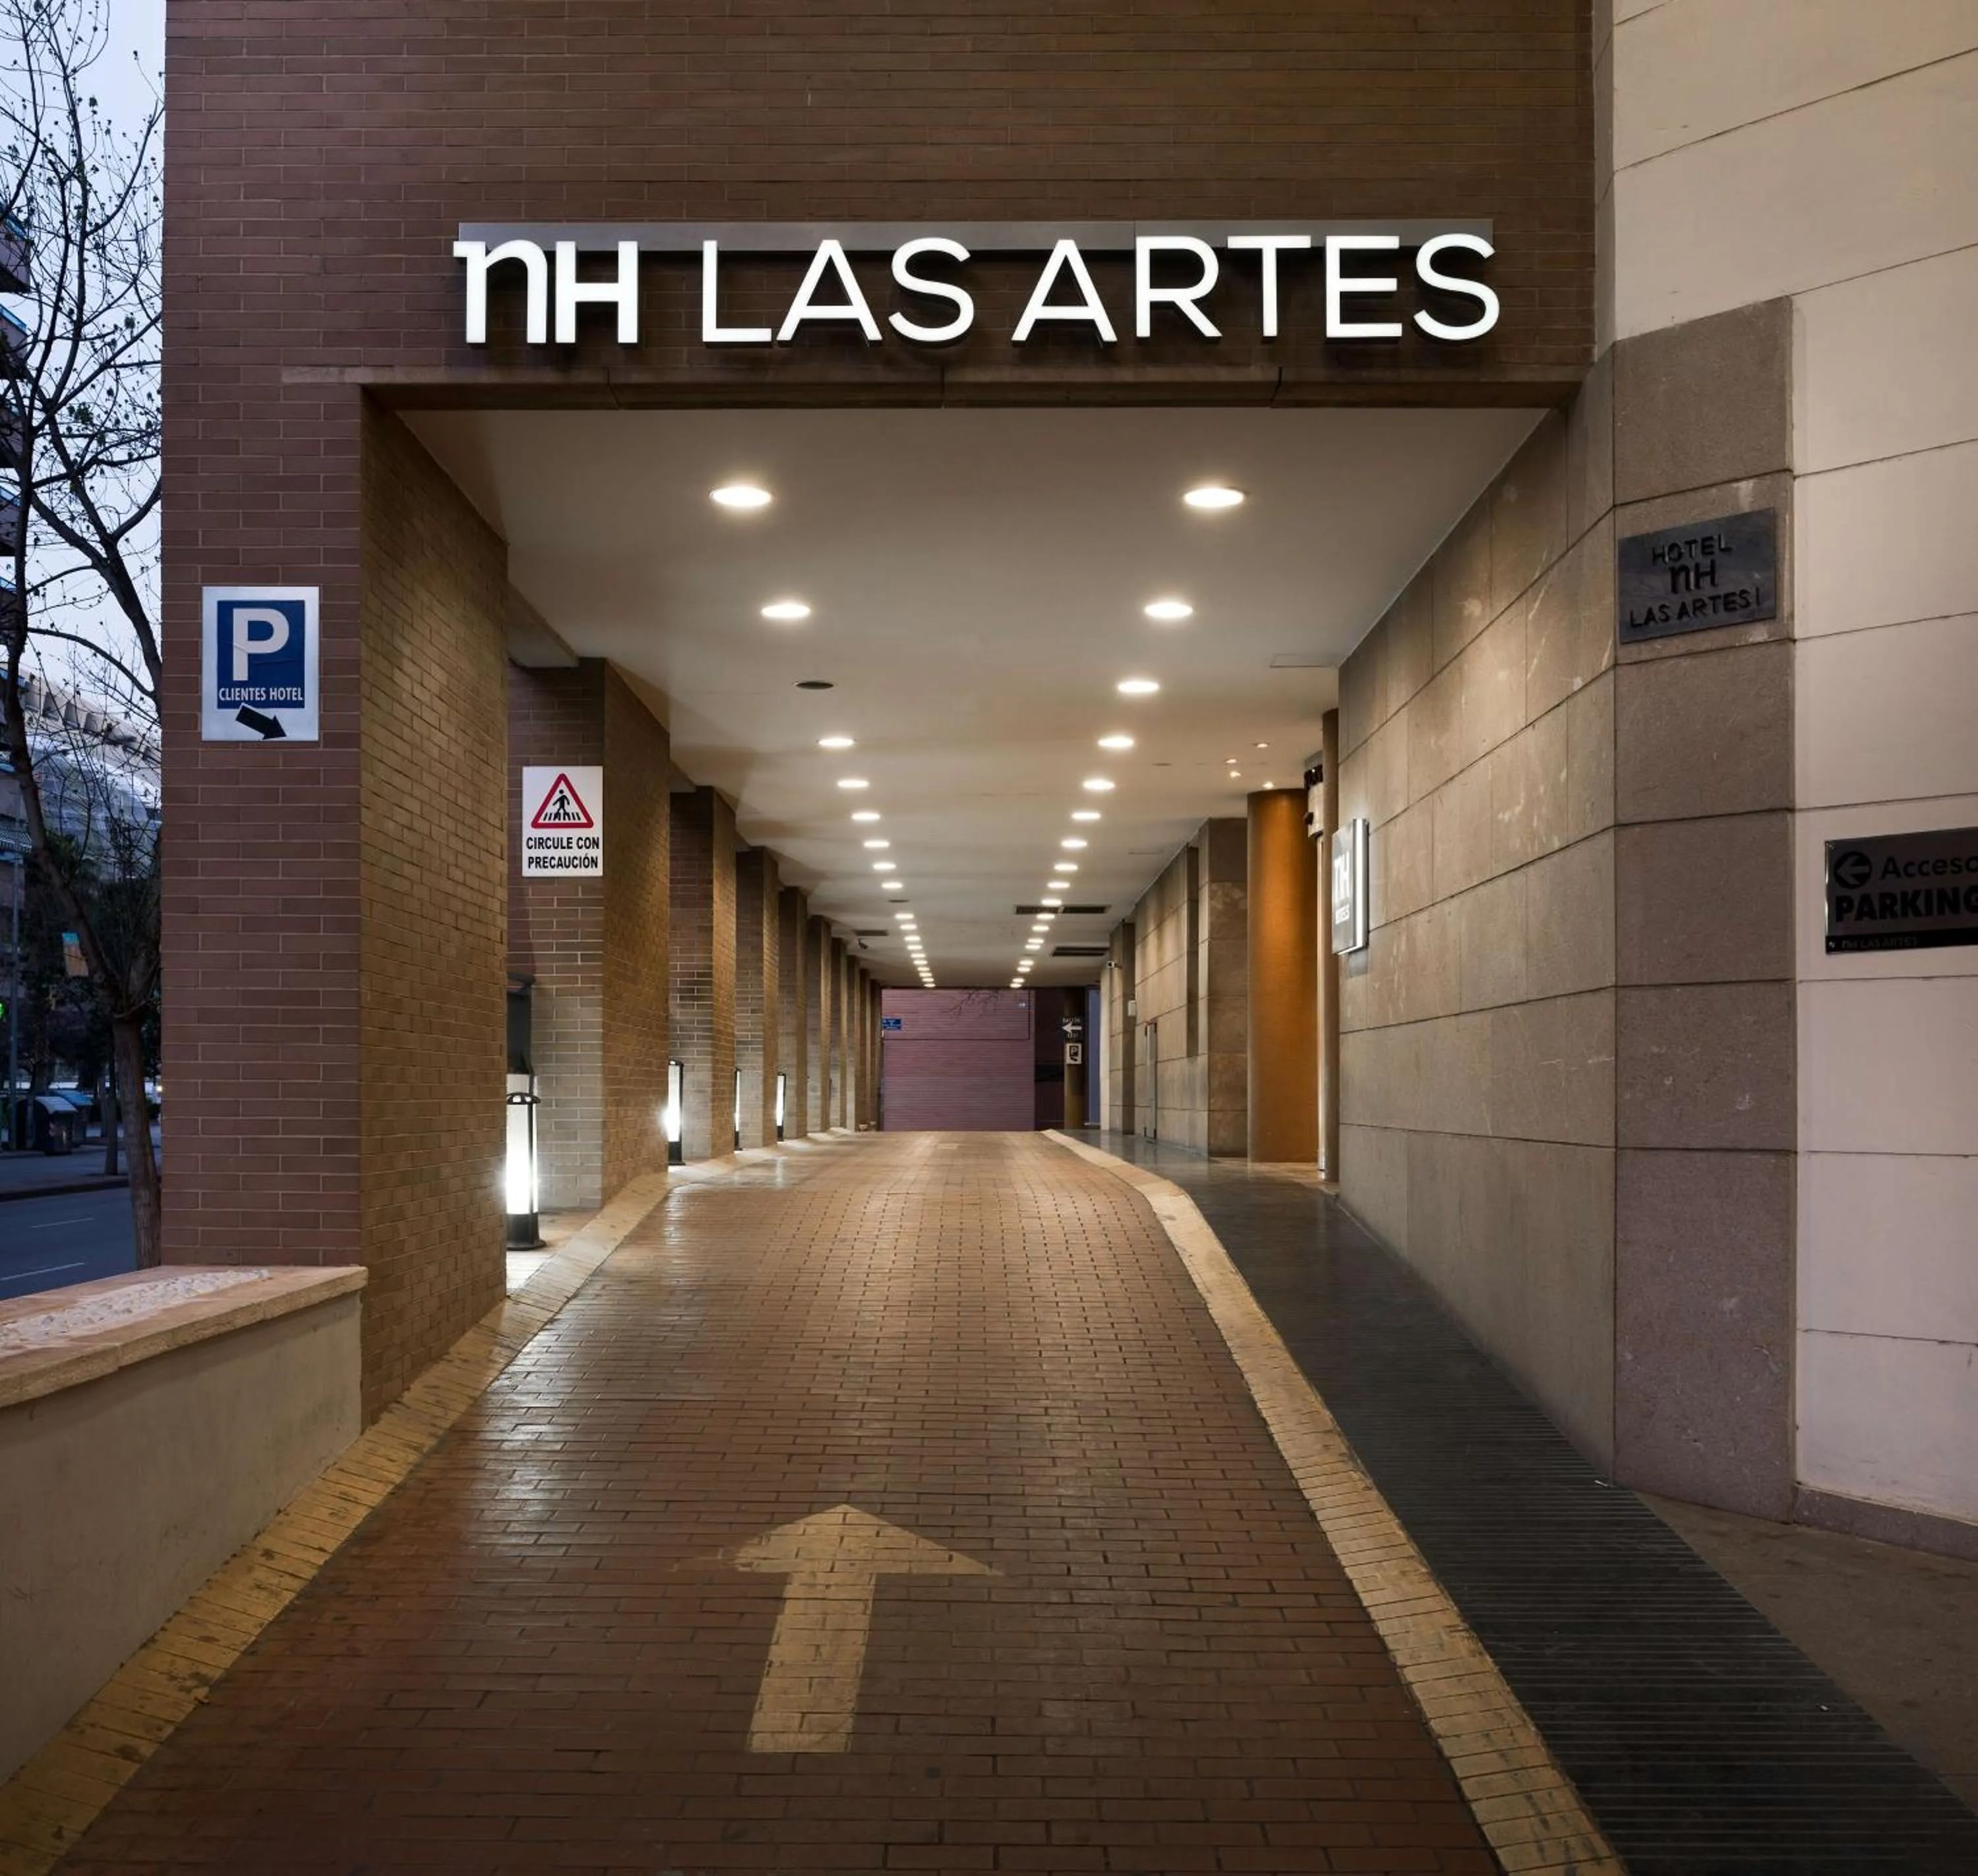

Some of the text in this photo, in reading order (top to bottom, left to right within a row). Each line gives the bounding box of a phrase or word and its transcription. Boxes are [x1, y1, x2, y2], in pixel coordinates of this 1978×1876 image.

[703, 238, 973, 341] LAS
[1012, 234, 1499, 341] ARTES
[1652, 534, 1733, 566] HOTEL
[1630, 602, 1670, 628] LAS
[1677, 589, 1751, 620] ARTES
[233, 608, 289, 681] P
[218, 688, 304, 701] CLIENTES HOTEL
[526, 836, 599, 850] CIRCULE CON
[528, 853, 598, 869] PRECAUCIÓN
[1880, 856, 1978, 881] Acceso
